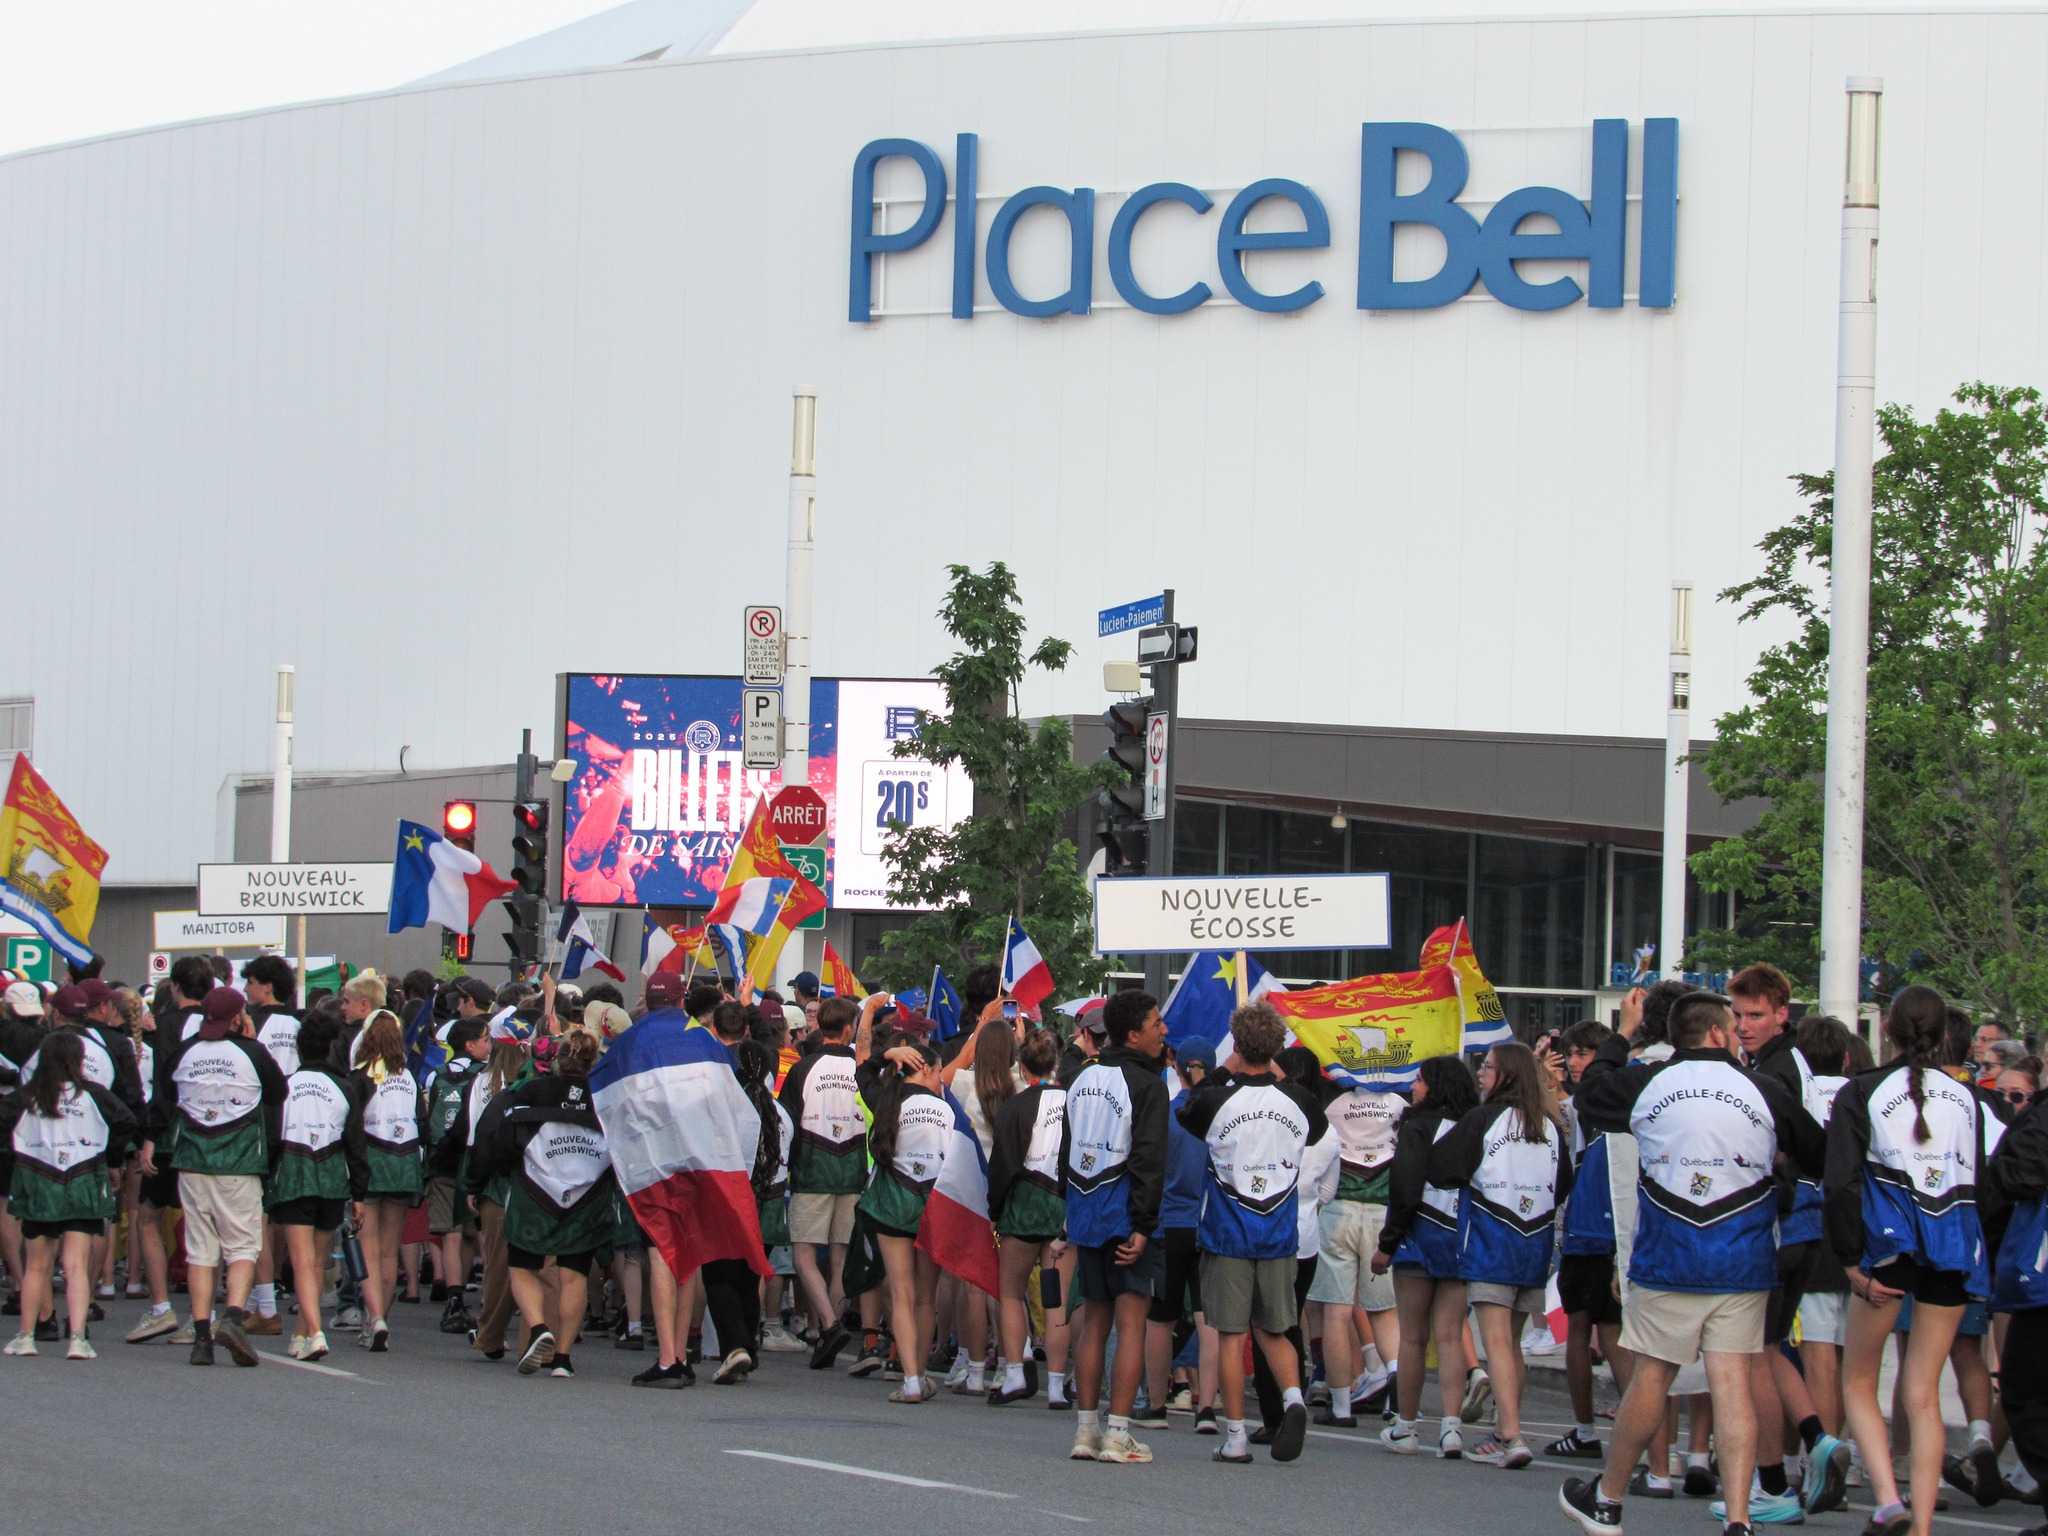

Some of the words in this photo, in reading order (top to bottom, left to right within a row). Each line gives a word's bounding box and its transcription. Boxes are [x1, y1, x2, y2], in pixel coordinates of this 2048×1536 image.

[848, 132, 1331, 323] Place
[1357, 117, 1680, 312] Bell
[756, 696, 770, 718] P
[633, 732, 677, 741] 2025
[772, 803, 825, 825] ARRÊT
[621, 835, 668, 857] DE
[673, 835, 741, 858] SAIS
[247, 870, 357, 887] NOUVEAU-
[240, 890, 366, 908] BRUNSWICK
[1161, 886, 1323, 911] NOUVELLE-
[182, 921, 256, 936] MANITOBA
[1189, 909, 1296, 939] ÉCOSSE
[17, 944, 42, 970] P
[192, 1058, 235, 1069] NOUVEAU-
[188, 1067, 238, 1079] BRUNSWICK
[291, 1089, 334, 1104] BRUNSWICK
[1349, 1101, 1389, 1111] NOUVEAU-
[1646, 1088, 1763, 1128] NOUVELLE-ÉCOSSE
[1343, 1110, 1395, 1121] BRUNSWICK
[1219, 1109, 1303, 1141] NOUVELLE-ÉCOSSE
[549, 1135, 598, 1147] NOUVEAU-
[545, 1145, 602, 1160] BRUNSWICK
[1913, 1151, 1943, 1162] Québec
[1242, 1163, 1267, 1172] Québec
[1680, 1157, 1713, 1167] Québec
[1480, 1181, 1508, 1190] Canada
[1513, 1183, 1535, 1192] Québec
